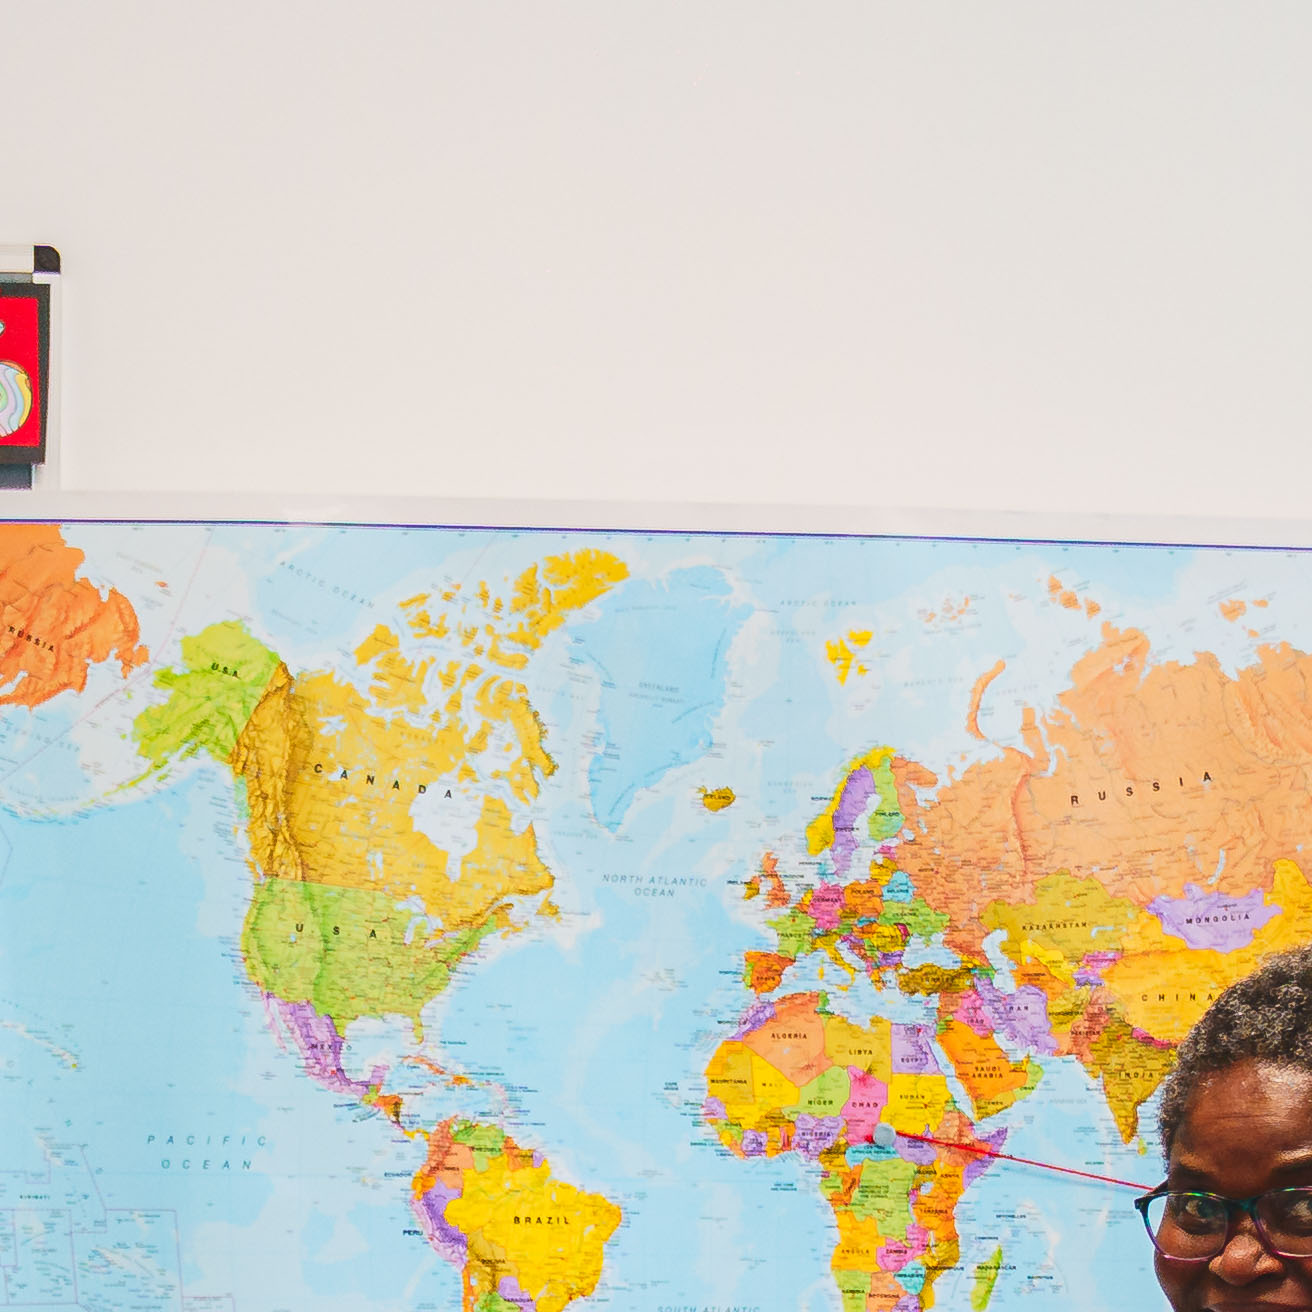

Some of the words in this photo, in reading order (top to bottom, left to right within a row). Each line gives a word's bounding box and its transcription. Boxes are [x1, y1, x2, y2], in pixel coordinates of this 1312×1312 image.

[7, 624, 56, 652] RUSSIA
[313, 763, 454, 800] CANADA
[1069, 771, 1213, 807] RUSSIA
[602, 873, 640, 886] NORTH
[645, 875, 707, 888] ATLANTIC
[634, 887, 676, 898] OCEAN
[1184, 912, 1251, 925] MONGOLIA
[1021, 921, 1088, 931] KAZAKHSTAN
[1140, 992, 1215, 1002] CHINA
[771, 1032, 807, 1040] ALGERIA
[309, 1042, 354, 1052] MEXICO
[1118, 1071, 1155, 1079] INDIA
[851, 1101, 879, 1109] CHAD
[146, 1134, 269, 1148] PACIFIC
[160, 1158, 254, 1171] OCEAN
[512, 1215, 571, 1226] BRAZIL
[402, 1229, 425, 1237] PERU
